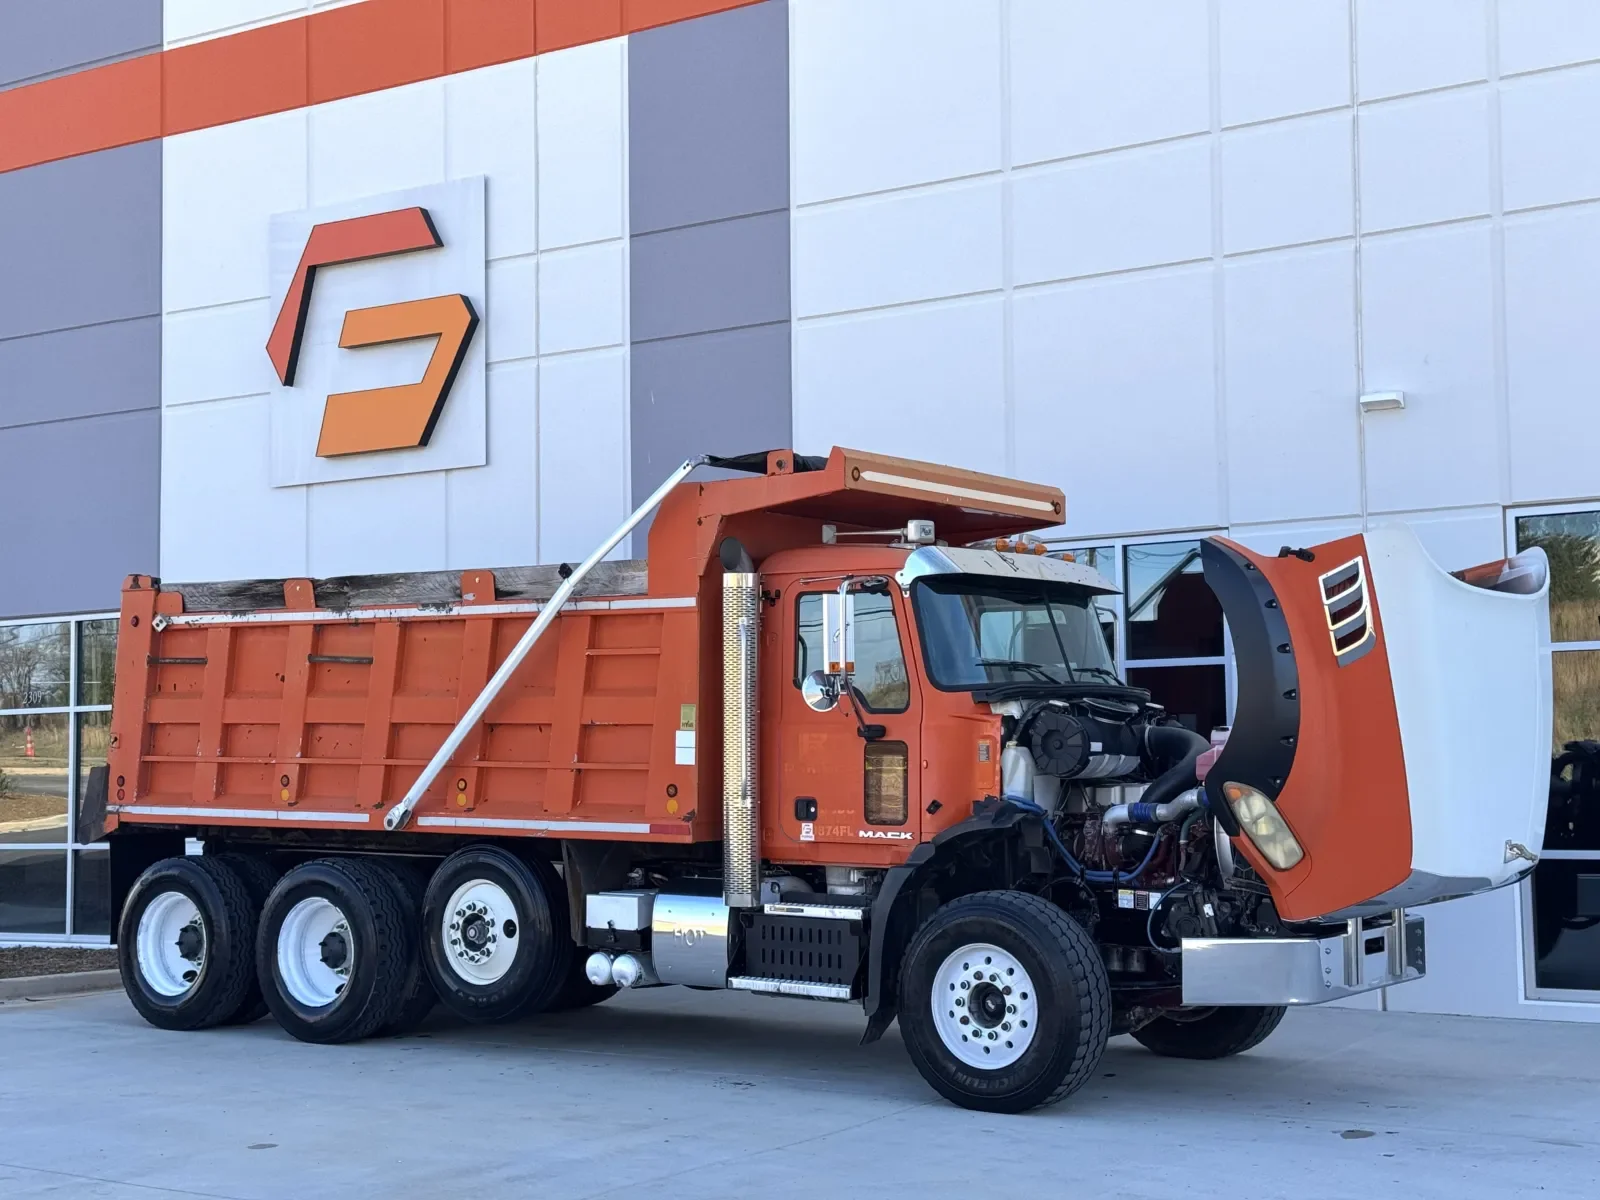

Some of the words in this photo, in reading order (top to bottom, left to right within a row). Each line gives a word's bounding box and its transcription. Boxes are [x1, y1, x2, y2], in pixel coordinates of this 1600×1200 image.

[22, 690, 42, 704] 2309
[858, 830, 913, 840] MACK
[673, 928, 706, 948] HOT
